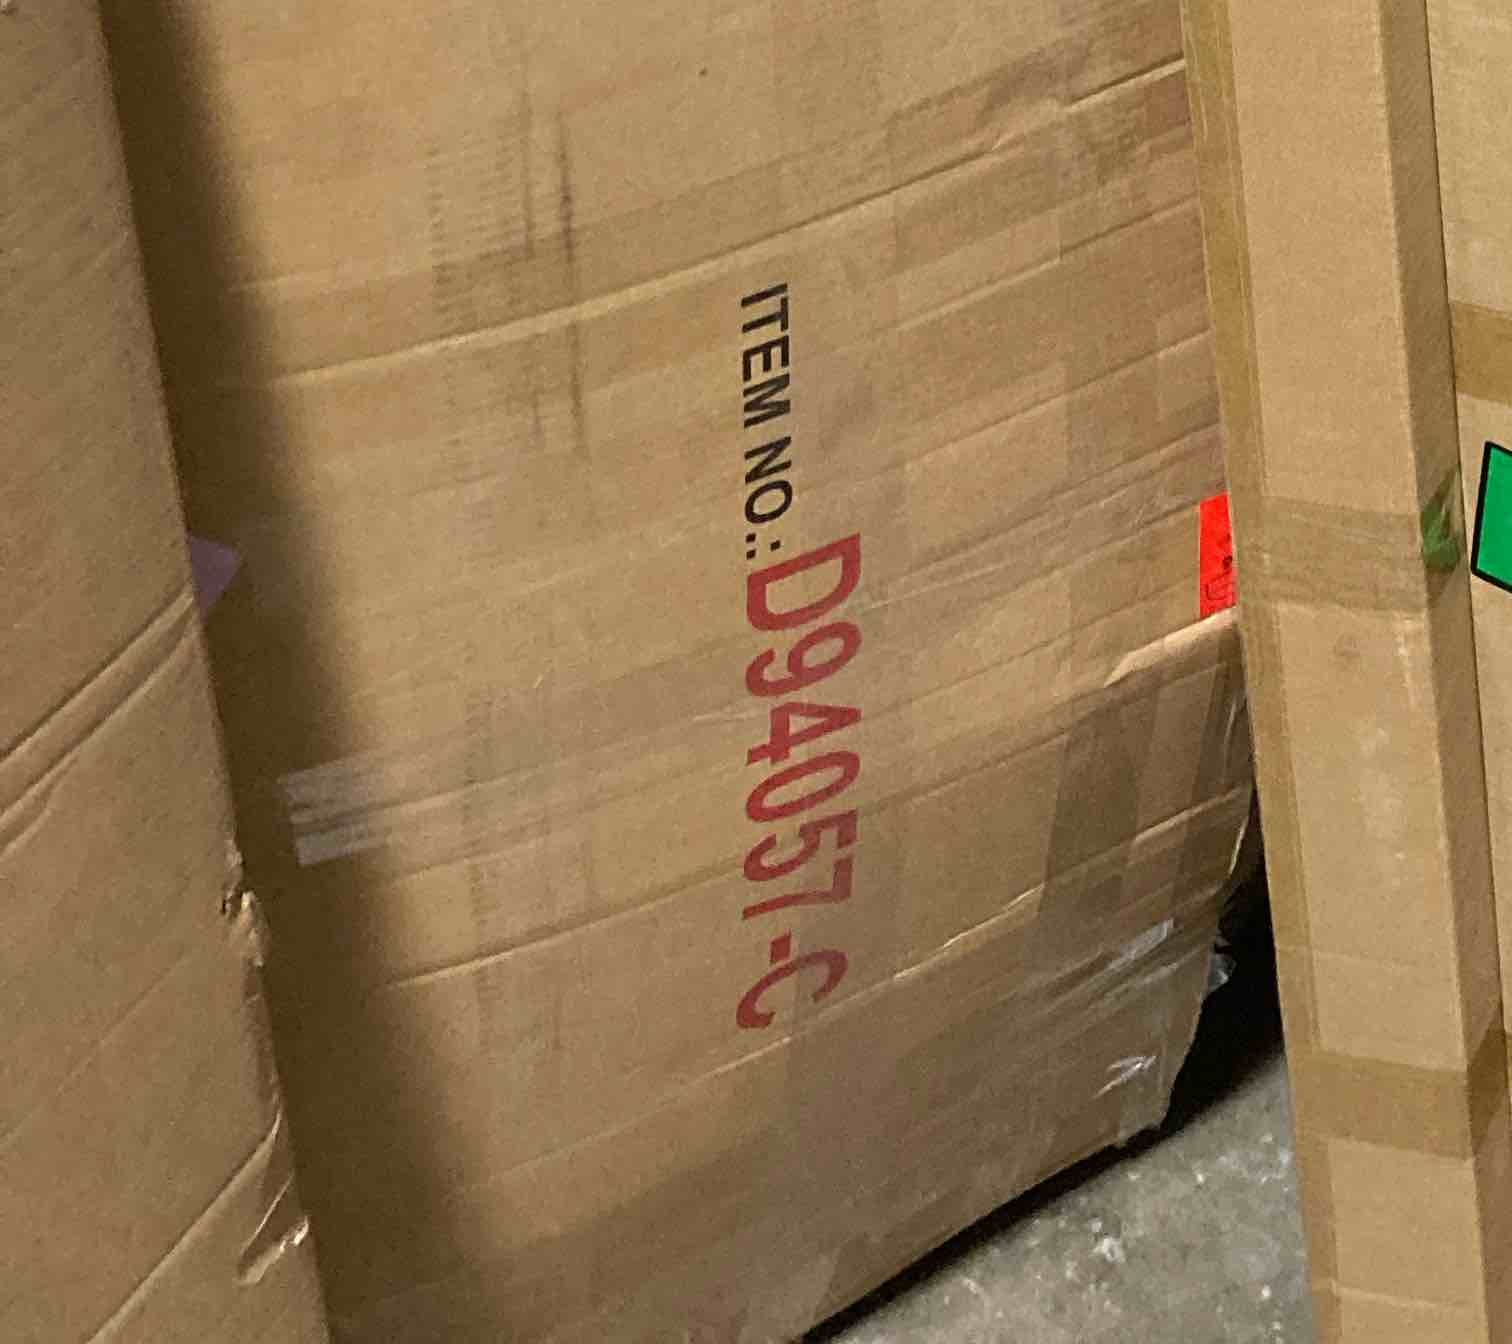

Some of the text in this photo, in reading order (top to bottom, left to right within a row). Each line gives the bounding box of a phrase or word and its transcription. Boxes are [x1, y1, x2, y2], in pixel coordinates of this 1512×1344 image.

[735, 282, 863, 1032] ITEM NO.: D94057-C
